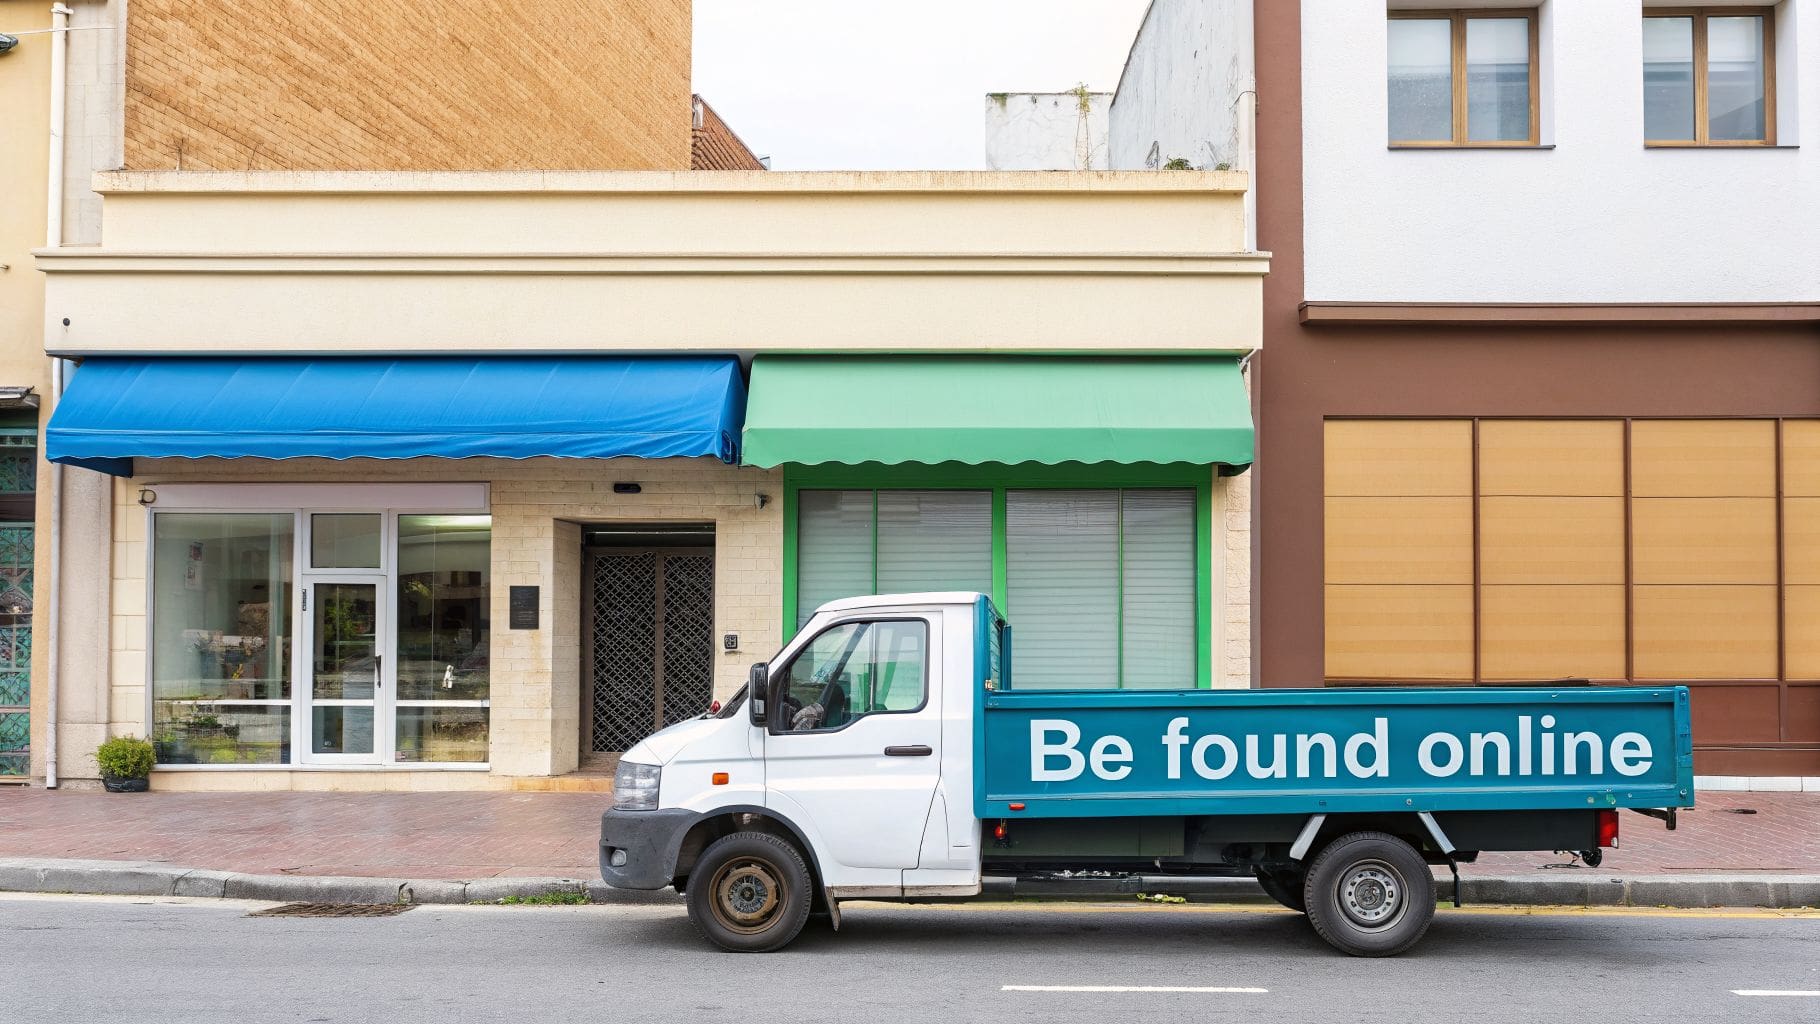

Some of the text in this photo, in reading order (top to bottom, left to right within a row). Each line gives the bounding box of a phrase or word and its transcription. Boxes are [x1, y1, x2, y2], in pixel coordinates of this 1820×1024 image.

[1030, 715, 1653, 782] Be found online
